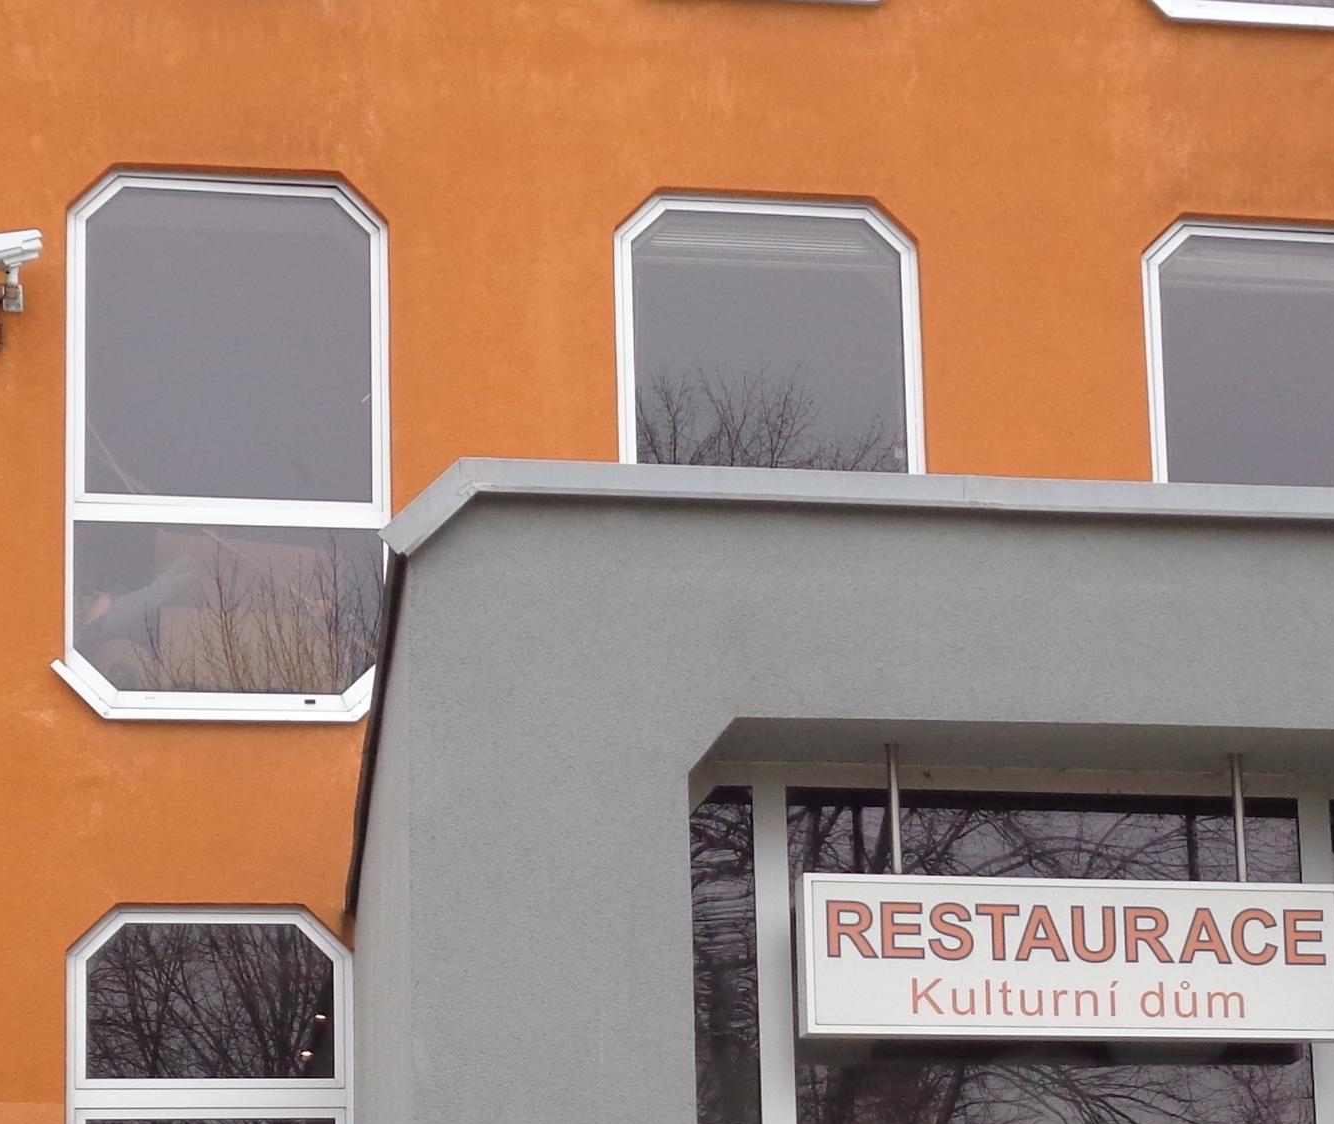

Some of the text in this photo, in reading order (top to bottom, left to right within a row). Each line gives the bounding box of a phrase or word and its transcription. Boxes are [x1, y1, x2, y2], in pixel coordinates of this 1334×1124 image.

[825, 900, 1327, 966] RESTAURACE
[910, 977, 1247, 1019] Kulturní dům
